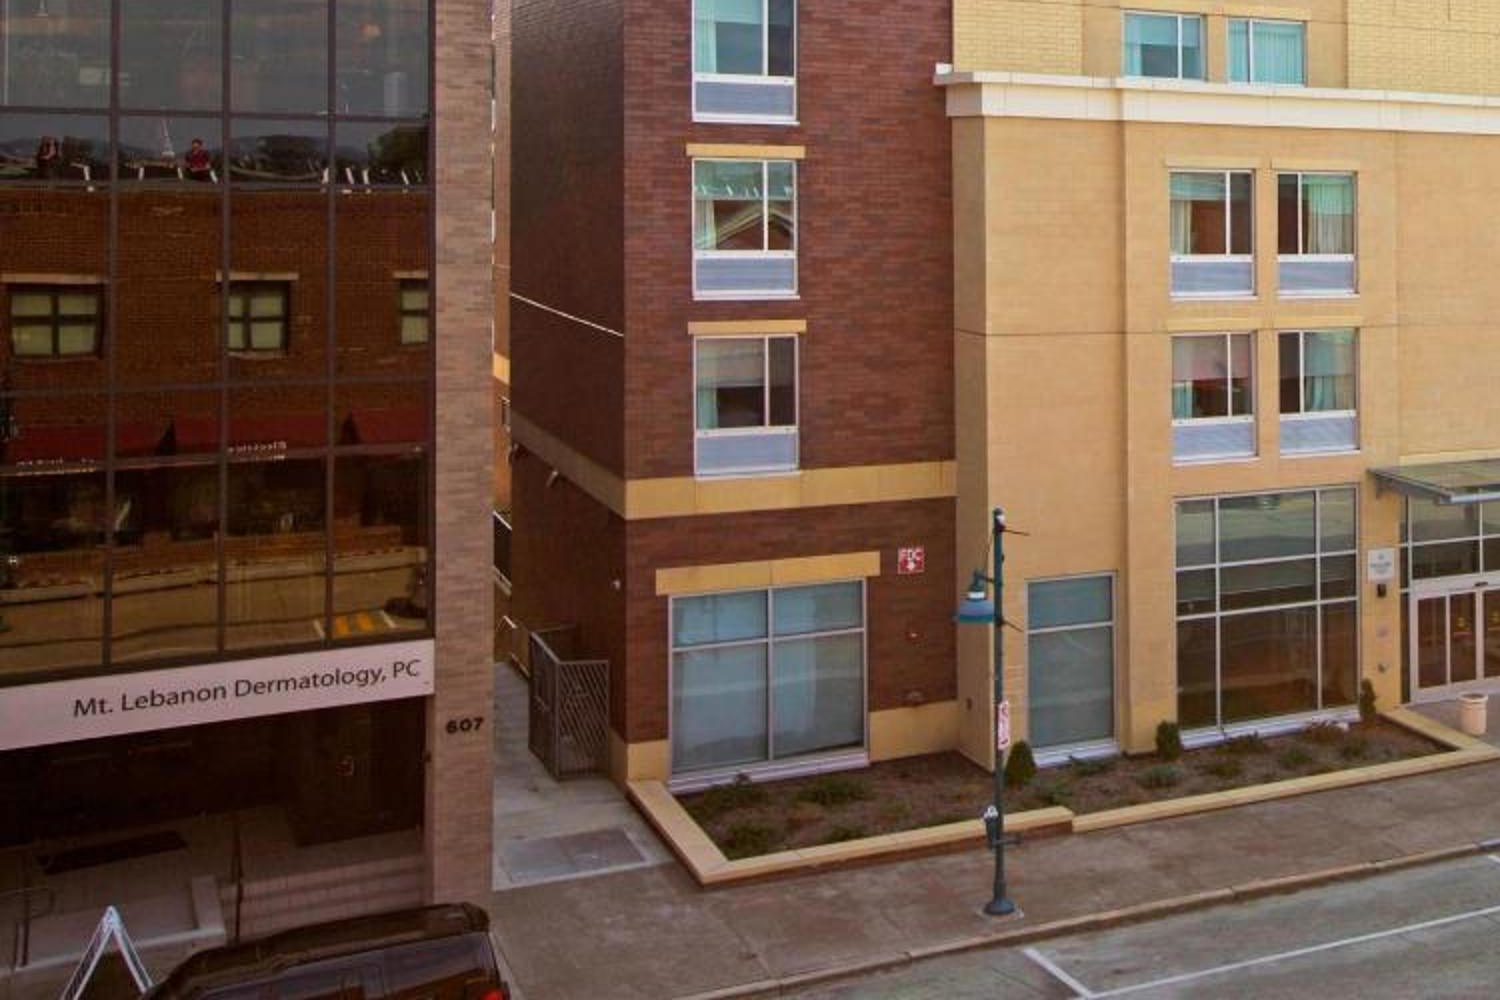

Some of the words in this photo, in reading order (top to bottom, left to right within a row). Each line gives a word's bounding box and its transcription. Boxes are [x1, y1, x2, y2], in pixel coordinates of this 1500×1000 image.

[72, 697, 114, 719] Mt.
[120, 684, 228, 713] Lebanon
[234, 667, 387, 698] Dermatology,
[392, 659, 421, 680] PC
[445, 716, 485, 736] 607
